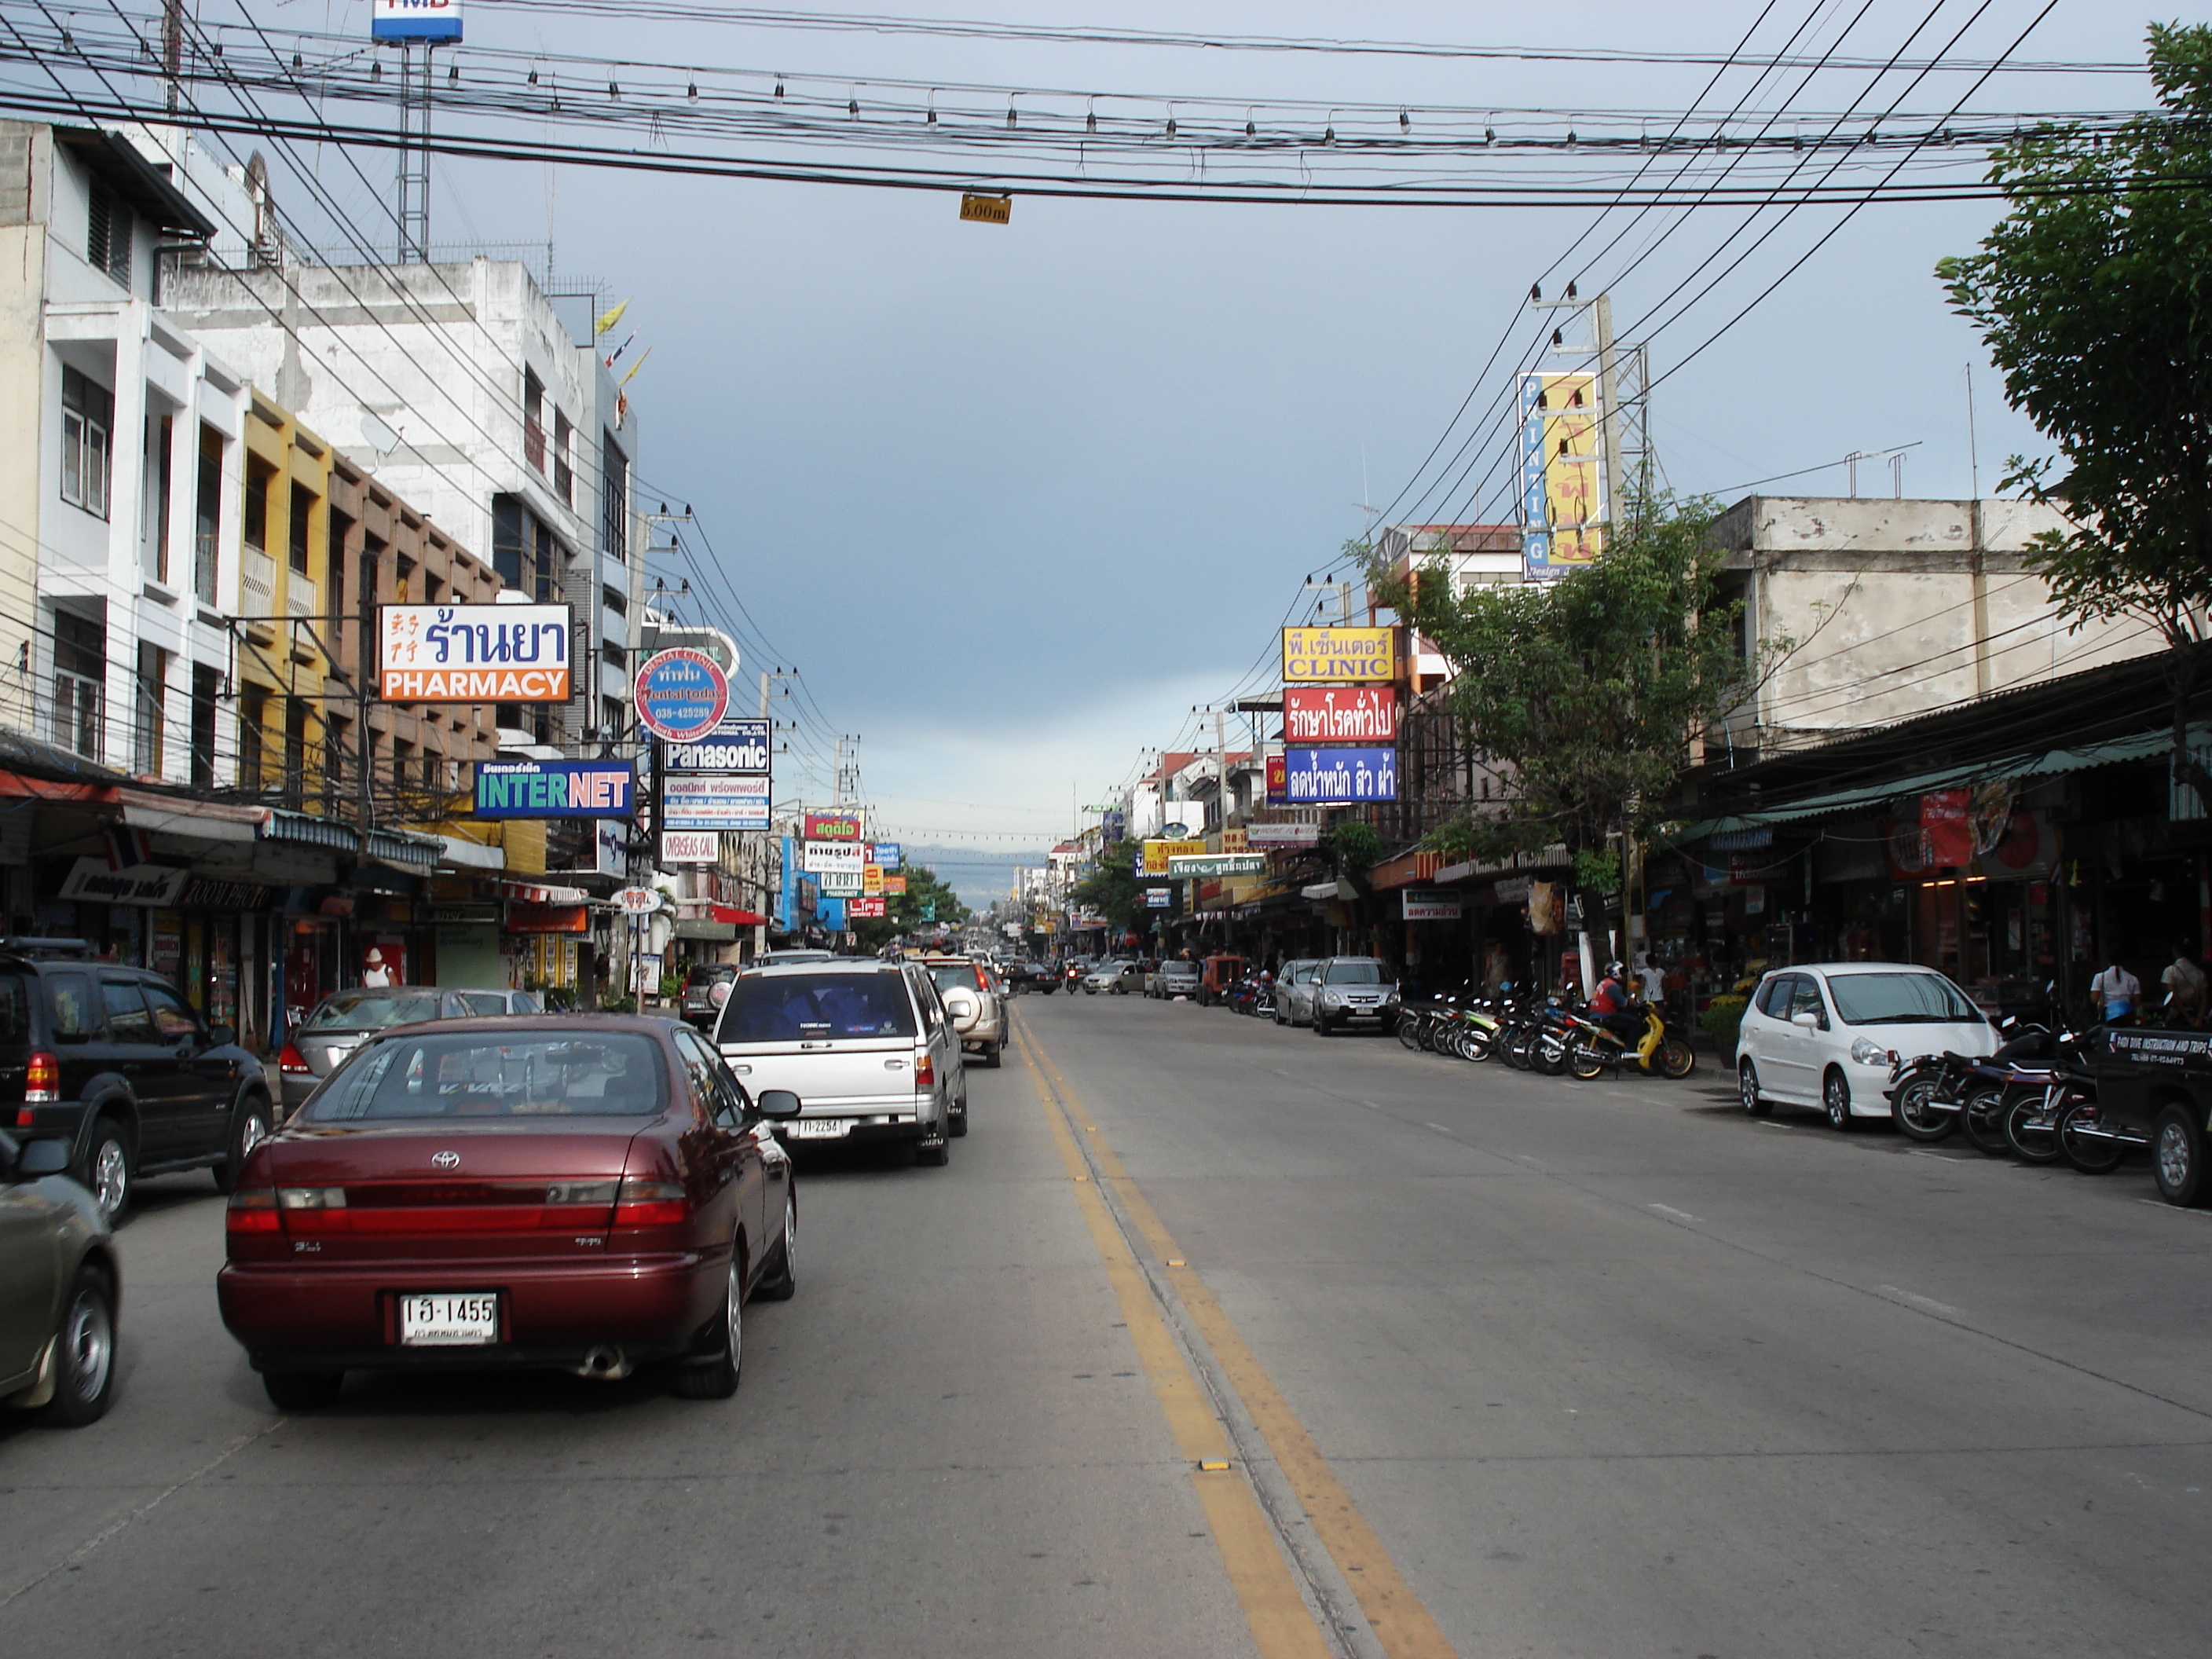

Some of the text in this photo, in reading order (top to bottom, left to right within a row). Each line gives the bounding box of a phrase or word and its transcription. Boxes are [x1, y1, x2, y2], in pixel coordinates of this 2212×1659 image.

[426, 609, 564, 663] ร้านยา
[644, 651, 679, 676] DENTAL
[683, 651, 716, 674] CLINIC
[1288, 658, 1388, 676] CLINIC
[386, 672, 565, 697] PHARMACY
[1289, 690, 1391, 736] รักษาโรคทั่วไป
[668, 738, 767, 768] Panasonic
[1291, 751, 1350, 797] ลดน้ำหนัก
[1356, 760, 1372, 796] สิว
[478, 772, 629, 808] INTERNET
[700, 836, 715, 856] CALL
[185, 879, 229, 905] ZOOM
[229, 883, 269, 909] PHOTO
[2188, 1041, 2208, 1054] TRIPS
